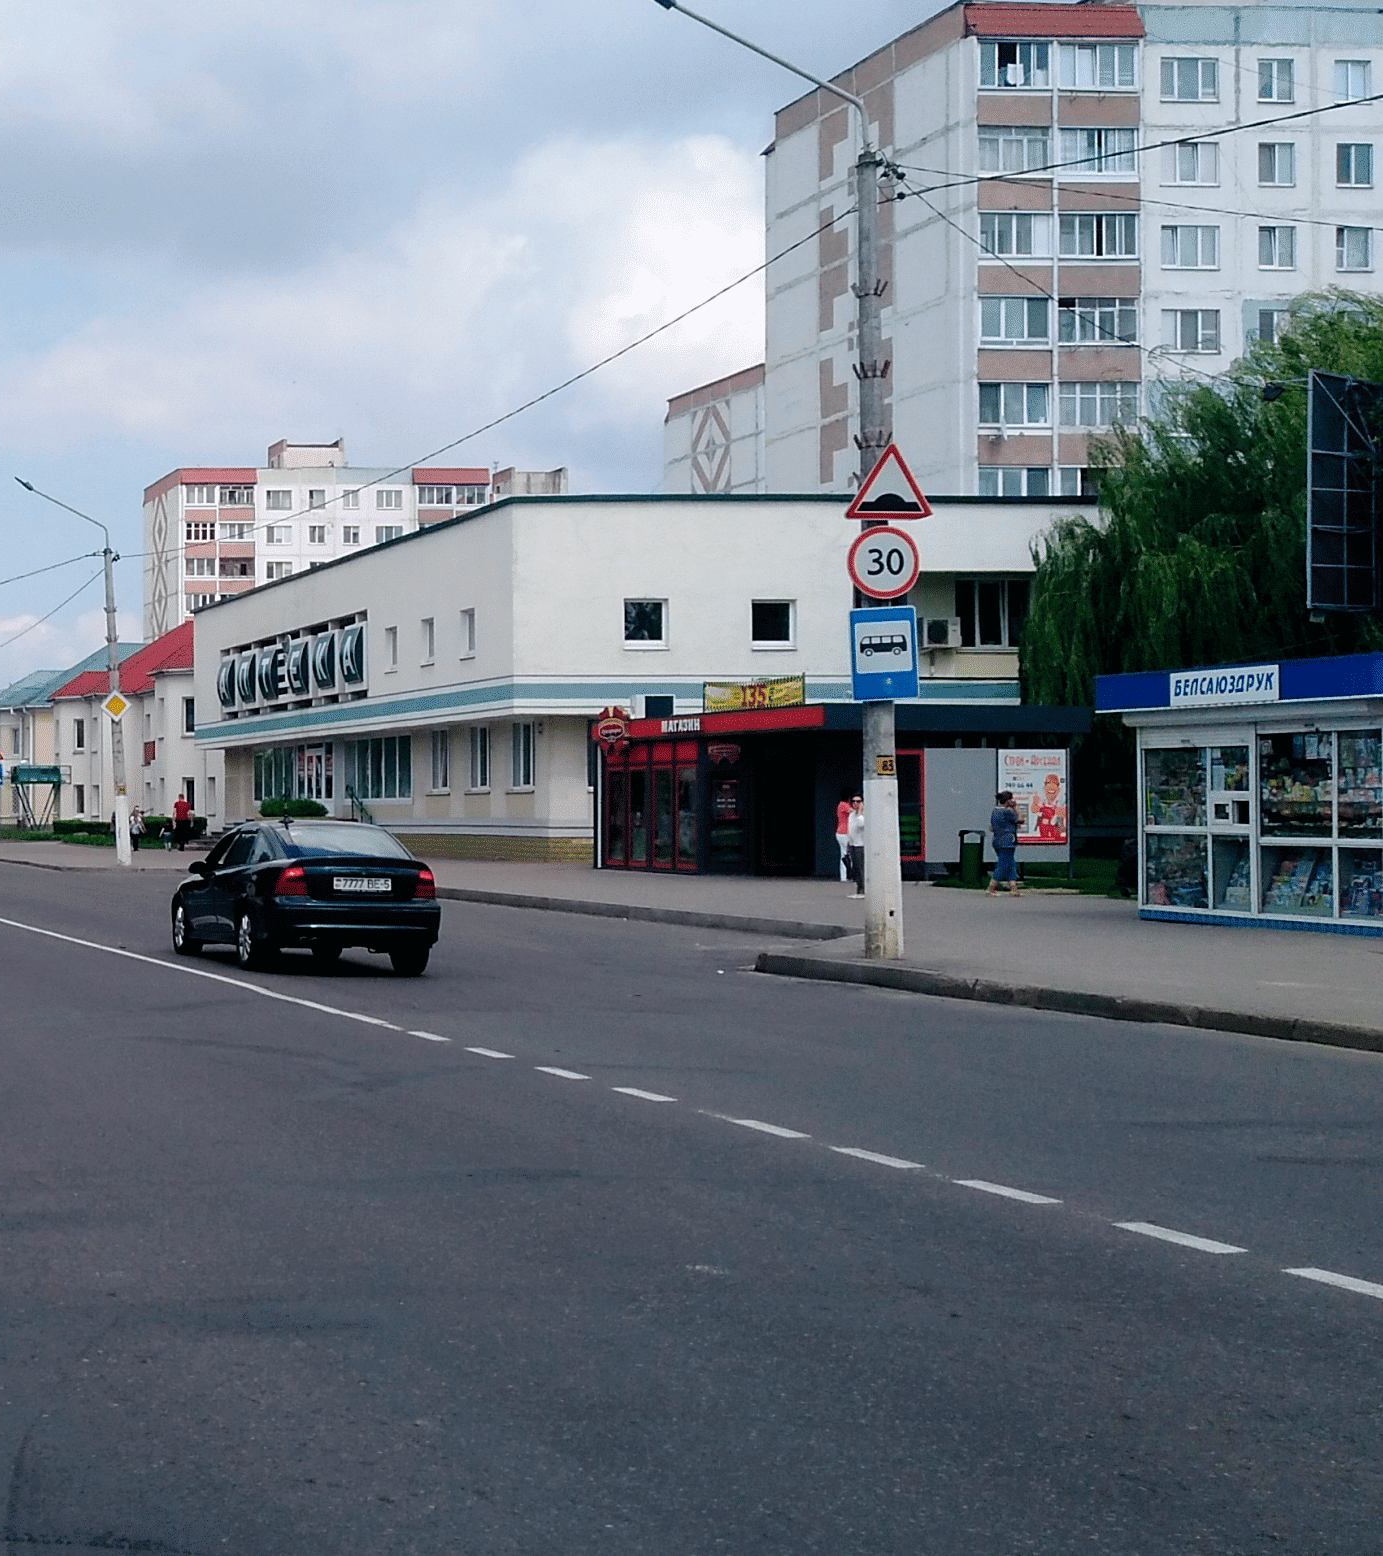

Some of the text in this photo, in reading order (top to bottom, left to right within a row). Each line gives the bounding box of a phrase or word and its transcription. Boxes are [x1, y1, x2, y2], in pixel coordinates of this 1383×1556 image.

[867, 548, 904, 575] 30
[219, 634, 357, 700] АПТЕКА
[1174, 672, 1274, 697] БЕЛСАЮЗДРУК
[661, 718, 700, 733] МАГАЗИН
[343, 878, 364, 889] 7777
